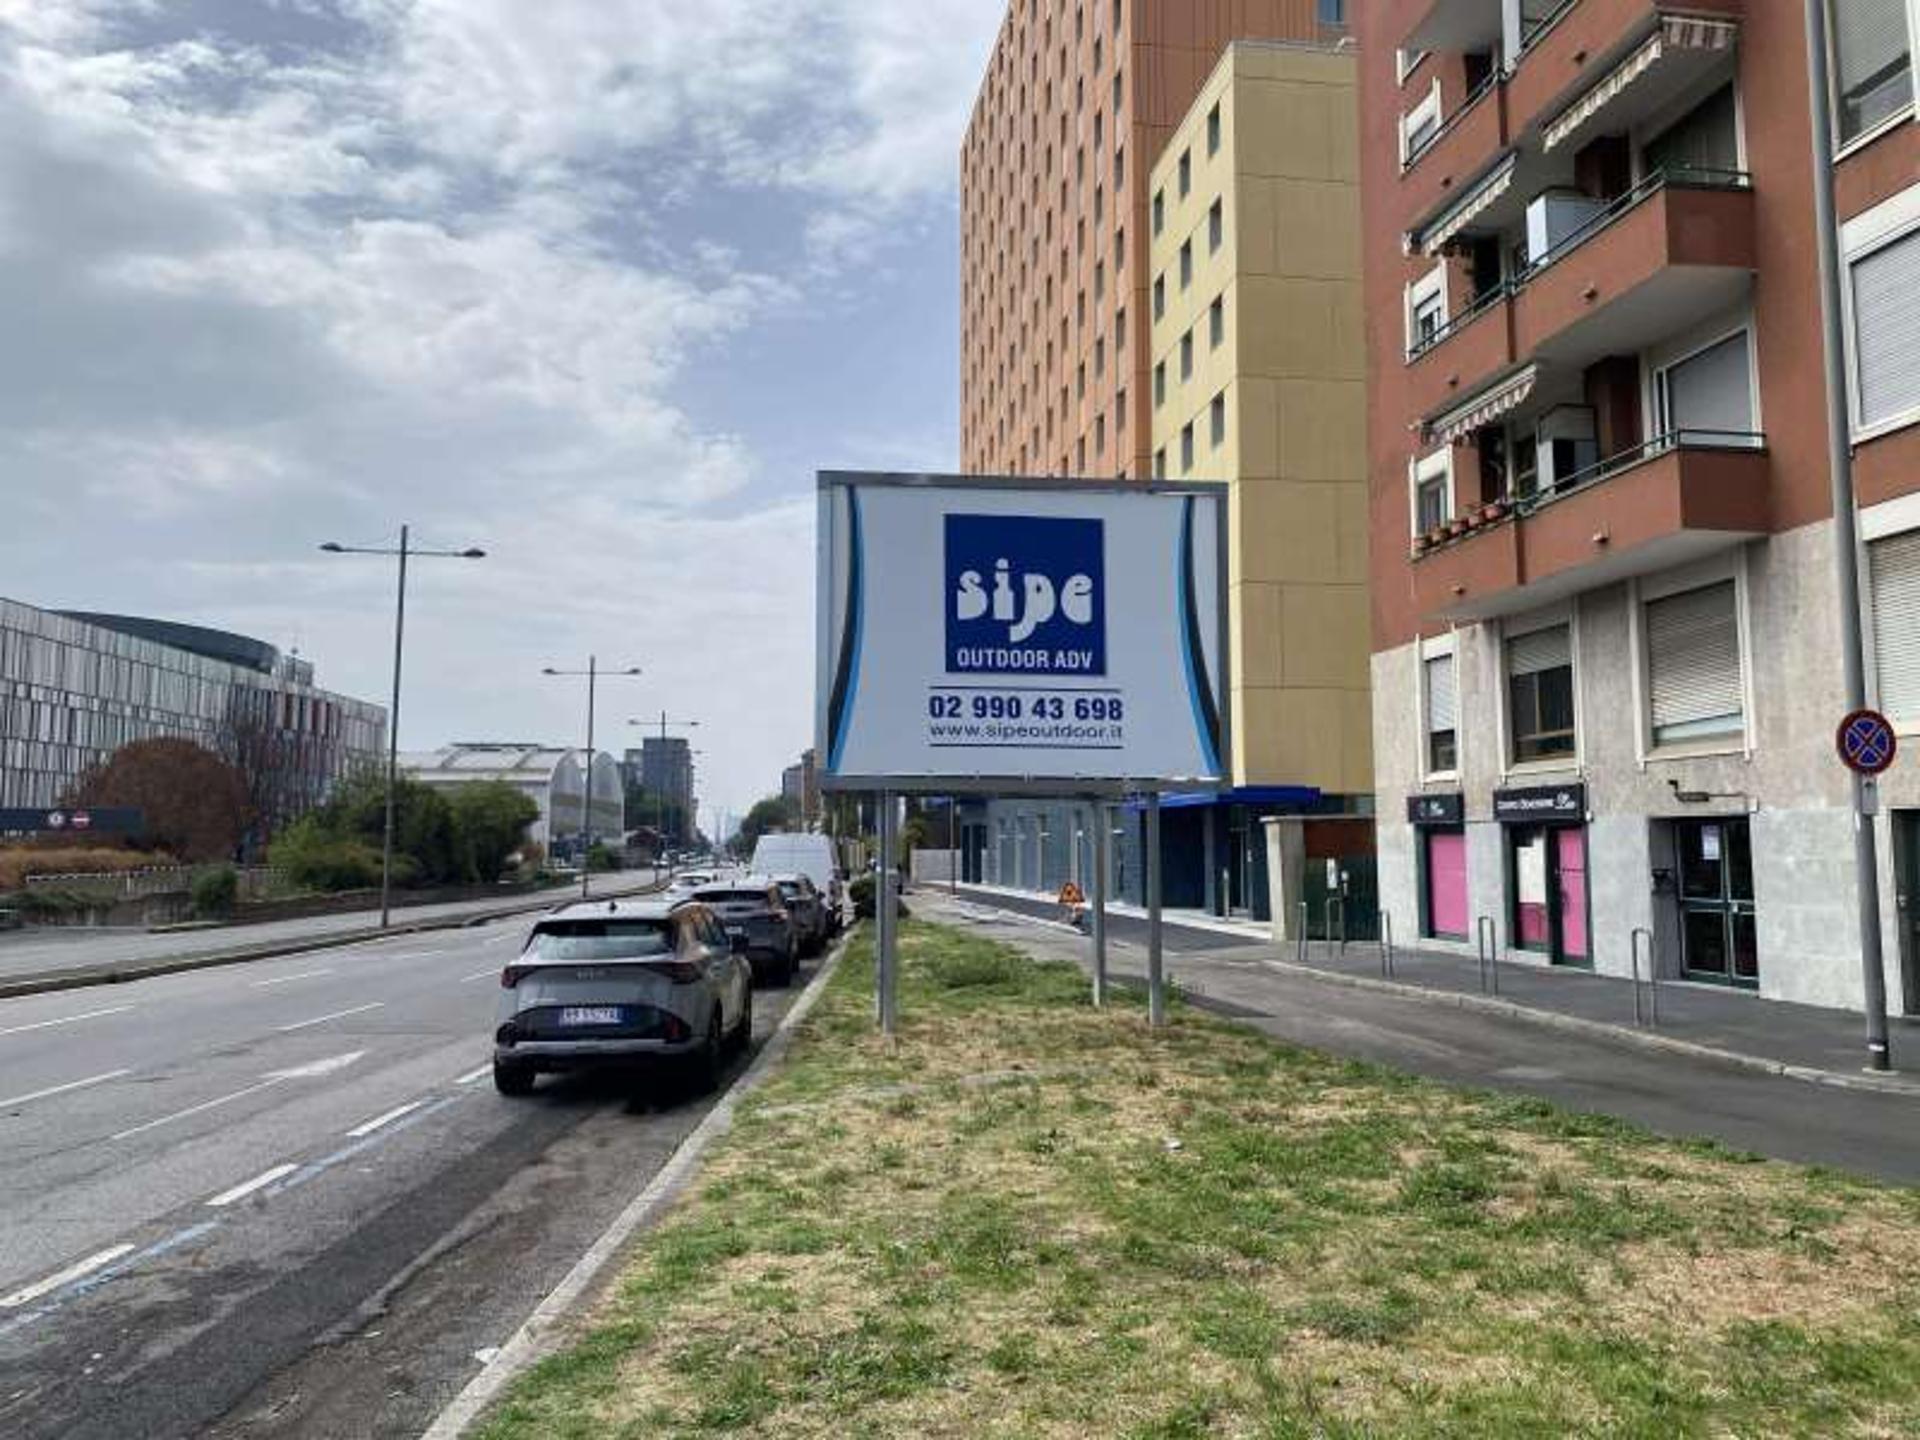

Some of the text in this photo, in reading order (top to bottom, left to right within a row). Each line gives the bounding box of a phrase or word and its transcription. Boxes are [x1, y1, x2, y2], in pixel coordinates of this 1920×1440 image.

[957, 558, 1093, 643] sipe
[957, 648, 1093, 669] OUTDOOR ADV
[929, 695, 1122, 721] 02 990 43 698
[930, 722, 1122, 739] www.sipeoutdoor.it
